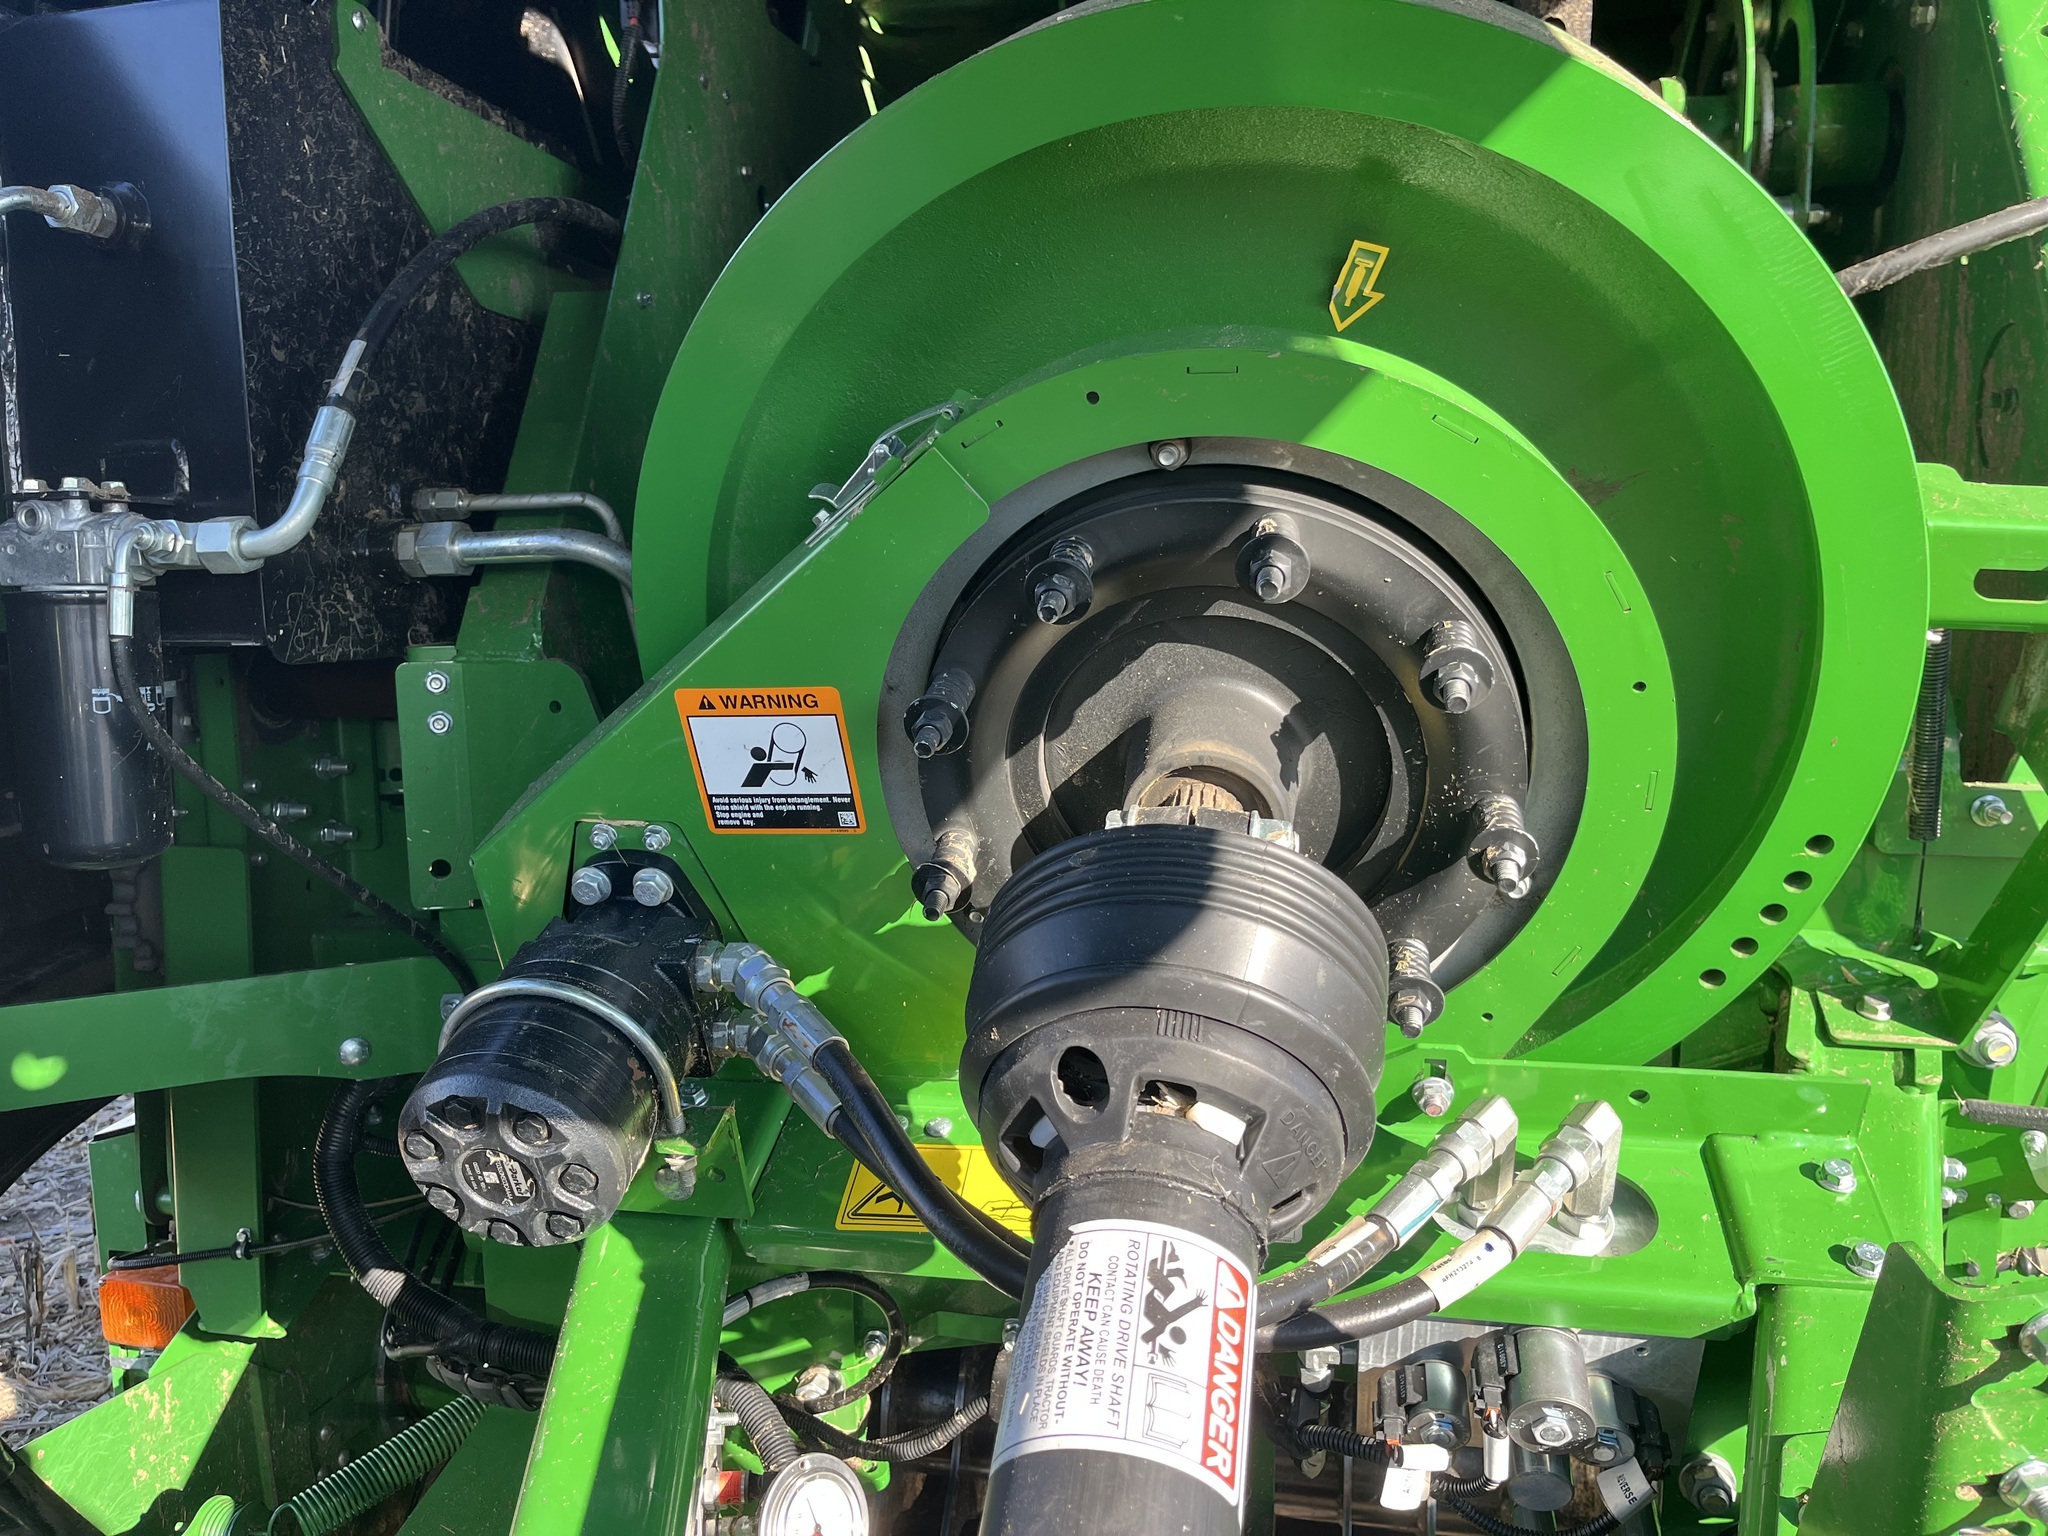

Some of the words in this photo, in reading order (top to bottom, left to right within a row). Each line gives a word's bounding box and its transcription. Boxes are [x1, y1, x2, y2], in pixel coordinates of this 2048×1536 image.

[718, 693, 819, 710] WARNING
[715, 811, 729, 819] Stop
[753, 796, 771, 804] injury
[775, 804, 796, 812] engine
[797, 804, 822, 812] running.
[743, 819, 756, 827] key.
[1279, 1109, 1328, 1169] DANGER
[508, 1164, 524, 1195] Parker
[1054, 1250, 1065, 1270] AND
[1064, 1247, 1074, 1266] ALL
[1078, 1240, 1090, 1253] DO
[1059, 1268, 1071, 1296] DRIVE
[1073, 1261, 1086, 1288] NOT
[1102, 1255, 1119, 1302] CONTACT
[1118, 1239, 1141, 1314] ROTATING
[1037, 1284, 1049, 1317] SHAFT
[1045, 1271, 1062, 1329] EQUIPMENT
[1054, 1297, 1067, 1329] SHAFT
[1082, 1271, 1102, 1322] KEEP
[1064, 1293, 1081, 1348] OPERATE
[1099, 1304, 1113, 1327] CAN
[1028, 1320, 1044, 1370] SECURELY
[1038, 1331, 1052, 1373] SHIELDS
[1045, 1330, 1061, 1378] GUARDS,
[1072, 1325, 1094, 1387] AWAY!
[1094, 1328, 1109, 1365] CAUSE
[1112, 1318, 1132, 1368] DRIVE
[1035, 1374, 1045, 1388] IN
[1088, 1367, 1104, 1405] DEATH
[1206, 1311, 1240, 1477] DANGER
[1029, 1389, 1042, 1424] PLACE
[1037, 1379, 1053, 1431] TRACTOR
[1104, 1373, 1125, 1430] SHAFT
[1614, 1472, 1638, 1506] REVERSE
